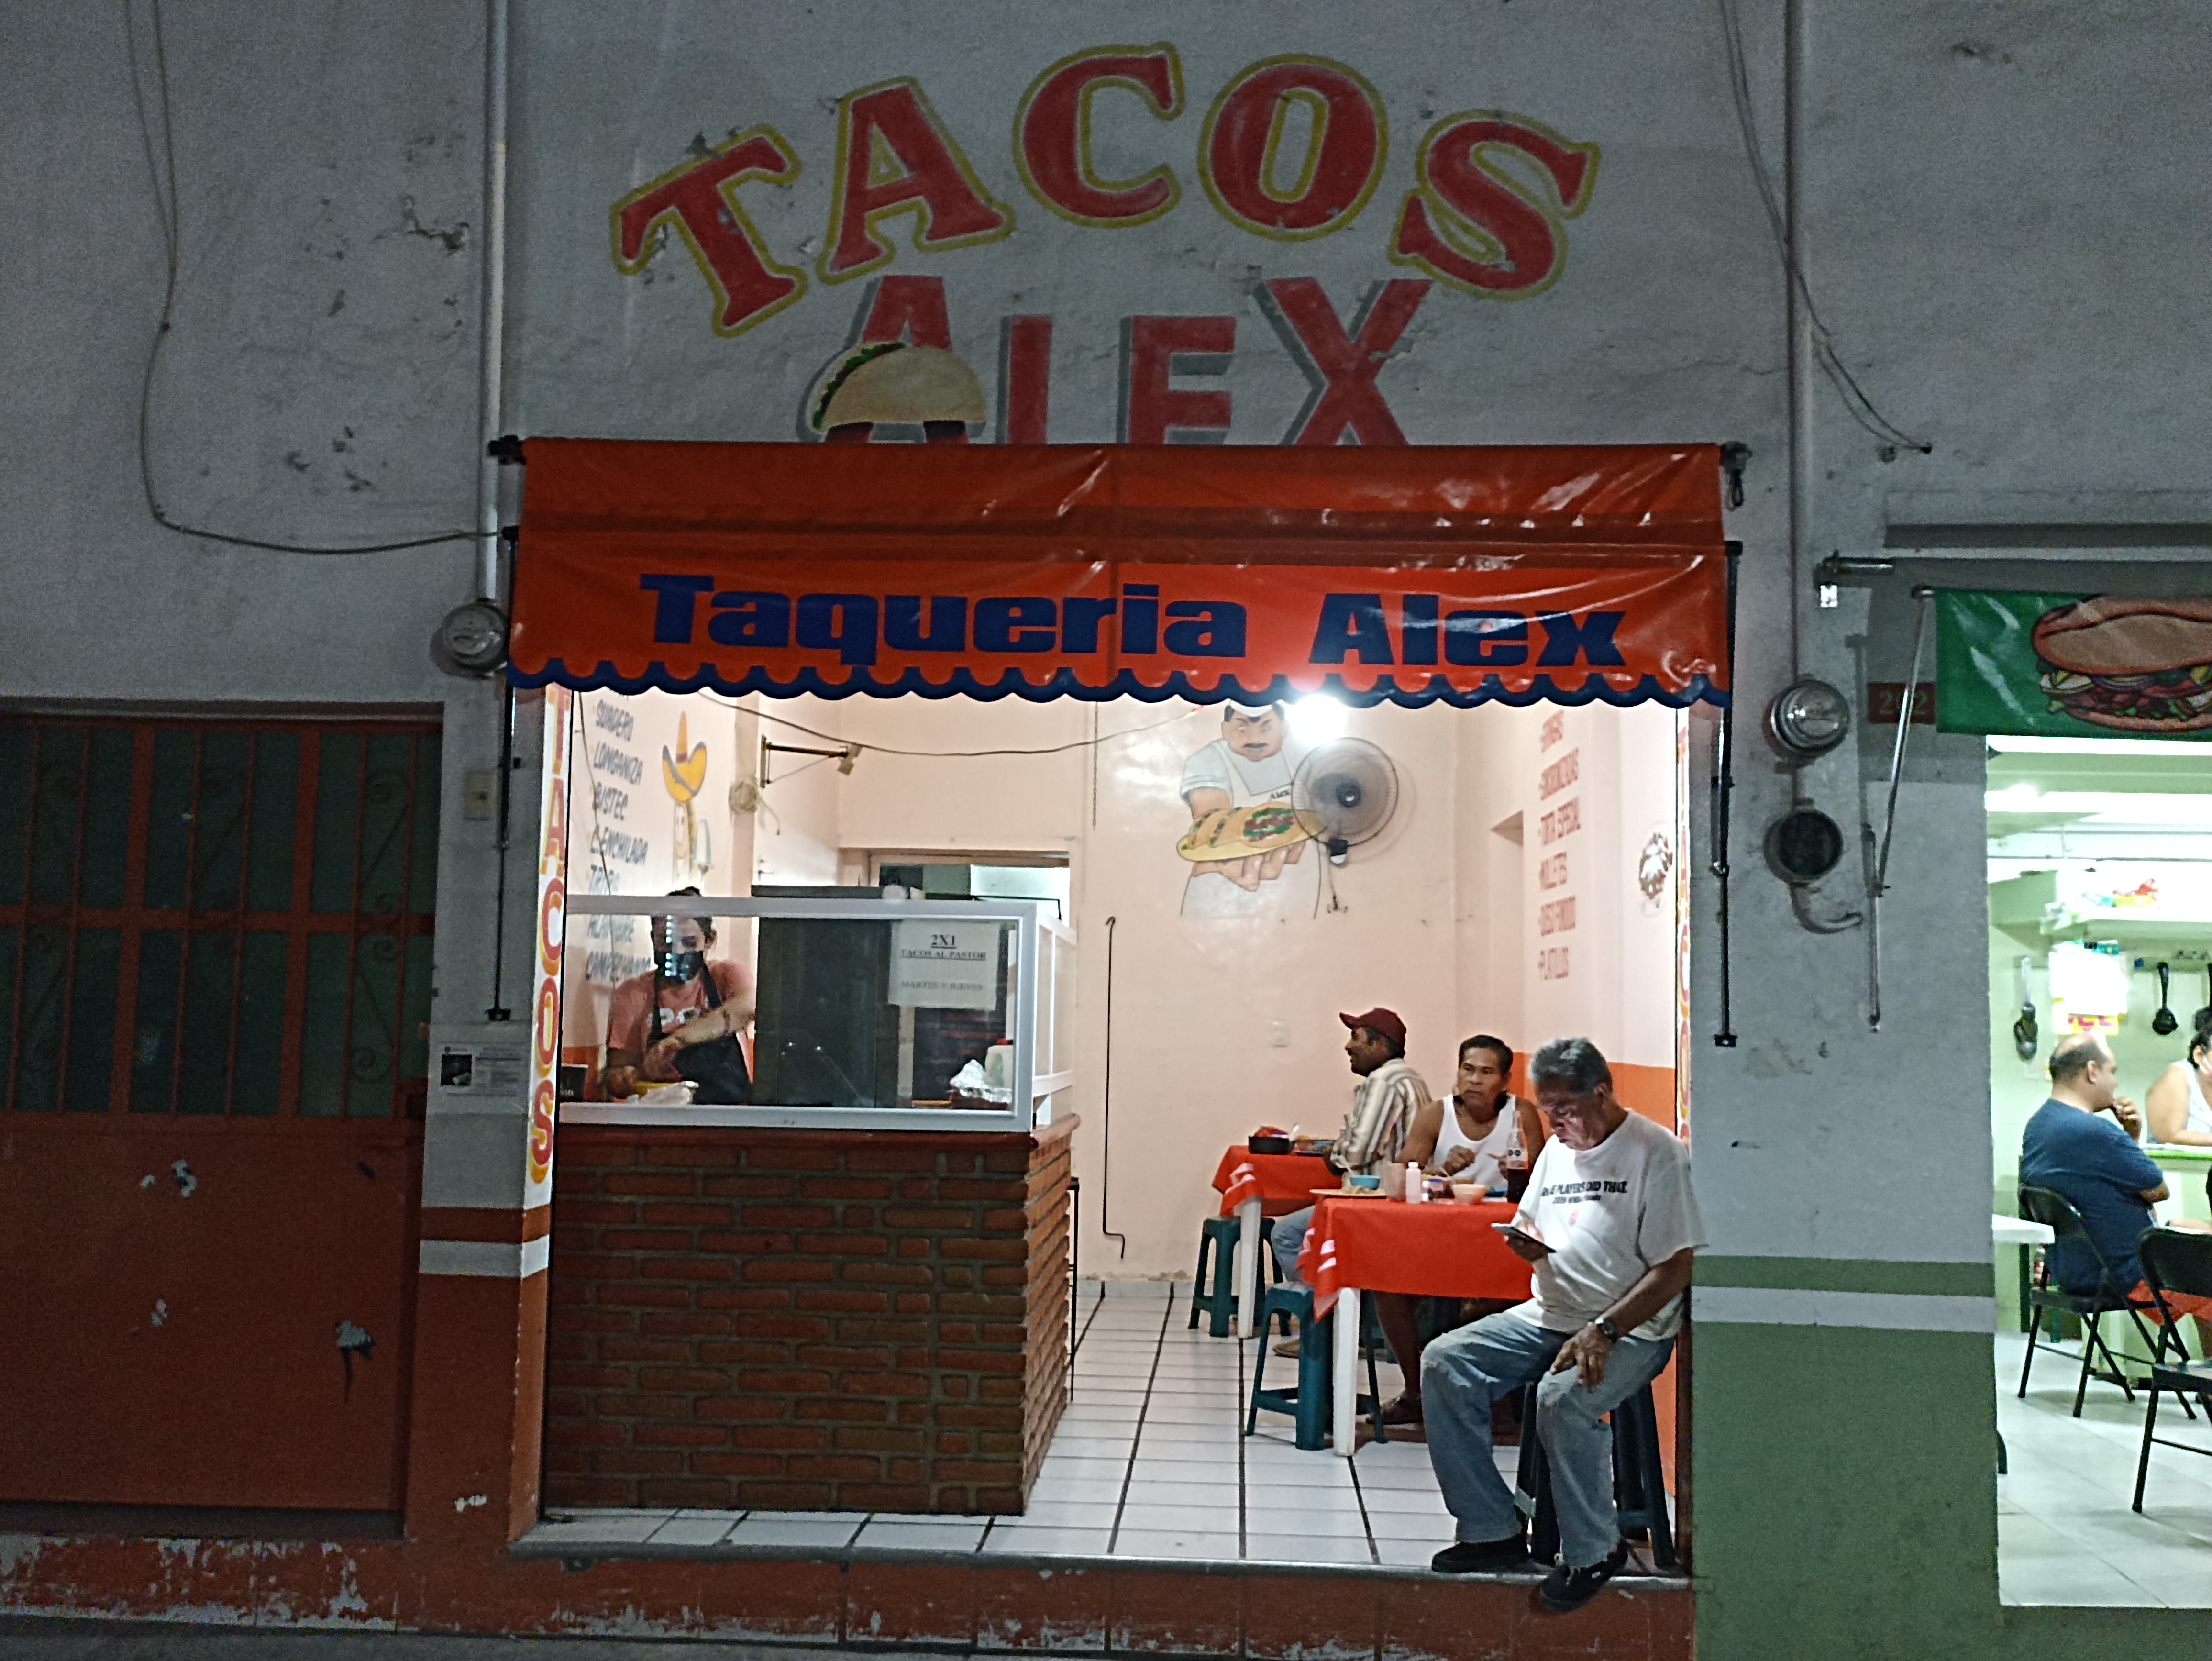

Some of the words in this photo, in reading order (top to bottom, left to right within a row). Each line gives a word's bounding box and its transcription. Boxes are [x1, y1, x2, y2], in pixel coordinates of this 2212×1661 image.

[610, 43, 1599, 336] TACOS
[639, 574, 1246, 666] Taqueria
[1309, 593, 1626, 667] Alex
[596, 699, 634, 742] SUADERO
[593, 741, 643, 786] LONGANIZA
[593, 781, 628, 821] BISTEC
[530, 684, 572, 1184] TACOS
[901, 949, 932, 957] TACOS
[949, 951, 986, 959] PASTOR
[931, 934, 956, 947] 2X1
[901, 981, 938, 989] MARTES
[950, 982, 983, 991] JUEVES
